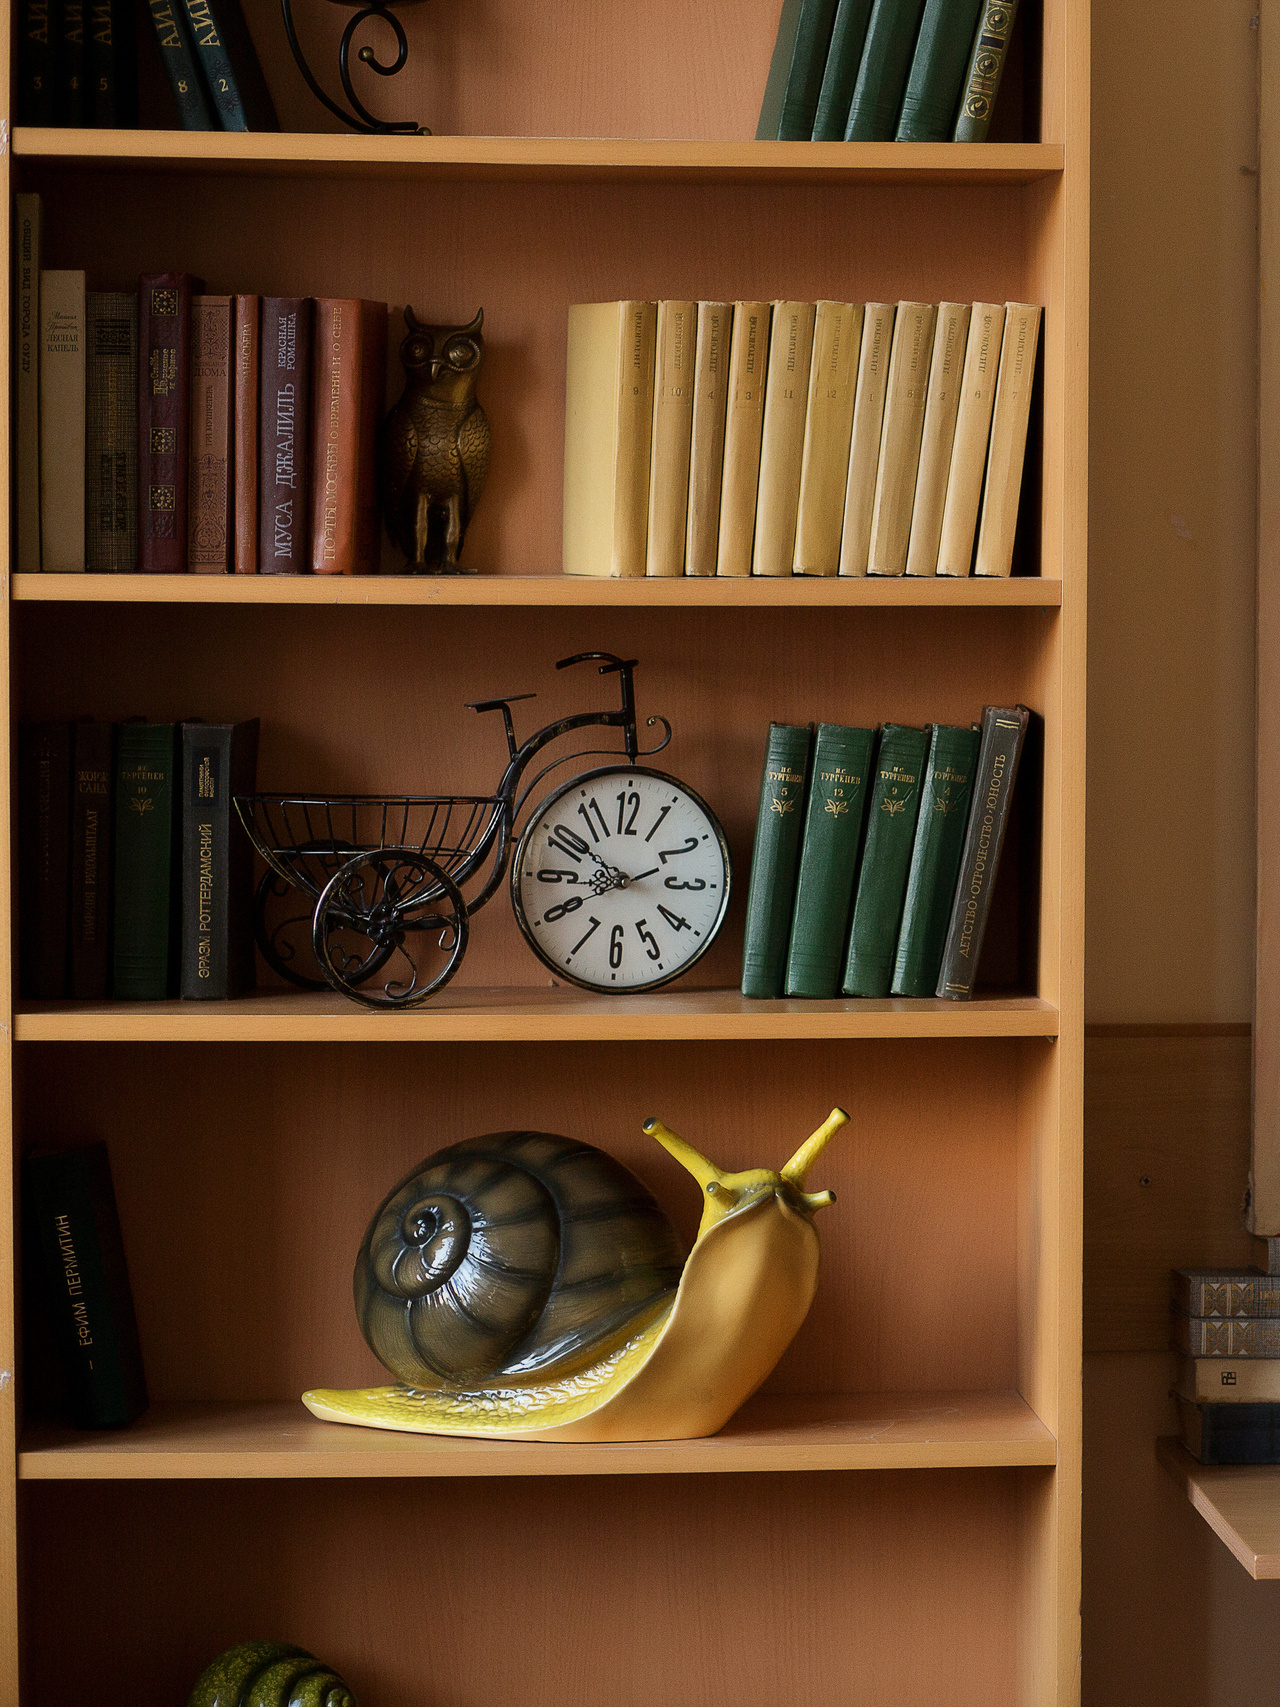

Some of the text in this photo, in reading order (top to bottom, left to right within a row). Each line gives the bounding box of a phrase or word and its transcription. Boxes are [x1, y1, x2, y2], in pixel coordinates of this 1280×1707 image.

[100, 77, 109, 91] 5
[178, 80, 189, 93] 8
[218, 78, 229, 92] 2
[22, 219, 32, 262] ОБЩИЙ
[22, 267, 31, 290] ВИД
[21, 295, 31, 338] ГОРОДА
[332, 307, 342, 339] СЕБЕ
[46, 334, 79, 352] ЛЕСНАЯ КАПЕЛЬ
[278, 316, 288, 369] КРАСНАЯ
[286, 312, 297, 371] РОМАШКА
[193, 367, 227, 377] ДЮМА
[329, 370, 341, 429] ВРЕМЕНИ
[274, 382, 298, 559] МУСА ДЖАЛИЛЬ
[325, 442, 338, 504] МОСКВЫ
[323, 506, 338, 561] ПОЭТЫ
[78, 771, 108, 794] ЖОРЖ САНД
[137, 786, 147, 794] 10
[768, 771, 803, 783] ТУРГЕНЕВ
[820, 772, 861, 785] ТУРГЕНЕВ
[880, 770, 915, 783] ТУРГЕНЕВ
[891, 786, 898, 795] 9
[934, 770, 968, 784] ТУРГЕНЕВ
[781, 787, 788, 796] 5
[833, 788, 844, 797] 12
[944, 787, 951, 796] 4
[577, 796, 612, 843] 11
[616, 791, 641, 836] 12
[644, 805, 672, 842] 1
[547, 823, 590, 863] 10
[658, 837, 699, 864] 2
[536, 868, 579, 885] 9
[664, 876, 707, 891] 3
[198, 823, 214, 979] ЭРАЗМ РОТТЕРДАМСКИЙ
[543, 895, 584, 923] 8
[656, 903, 692, 932] 4
[570, 915, 602, 955] 7
[608, 924, 625, 969] 6
[635, 918, 661, 961] 5
[54, 1214, 93, 1347] ЕФИМ ПЕРМИТИН
